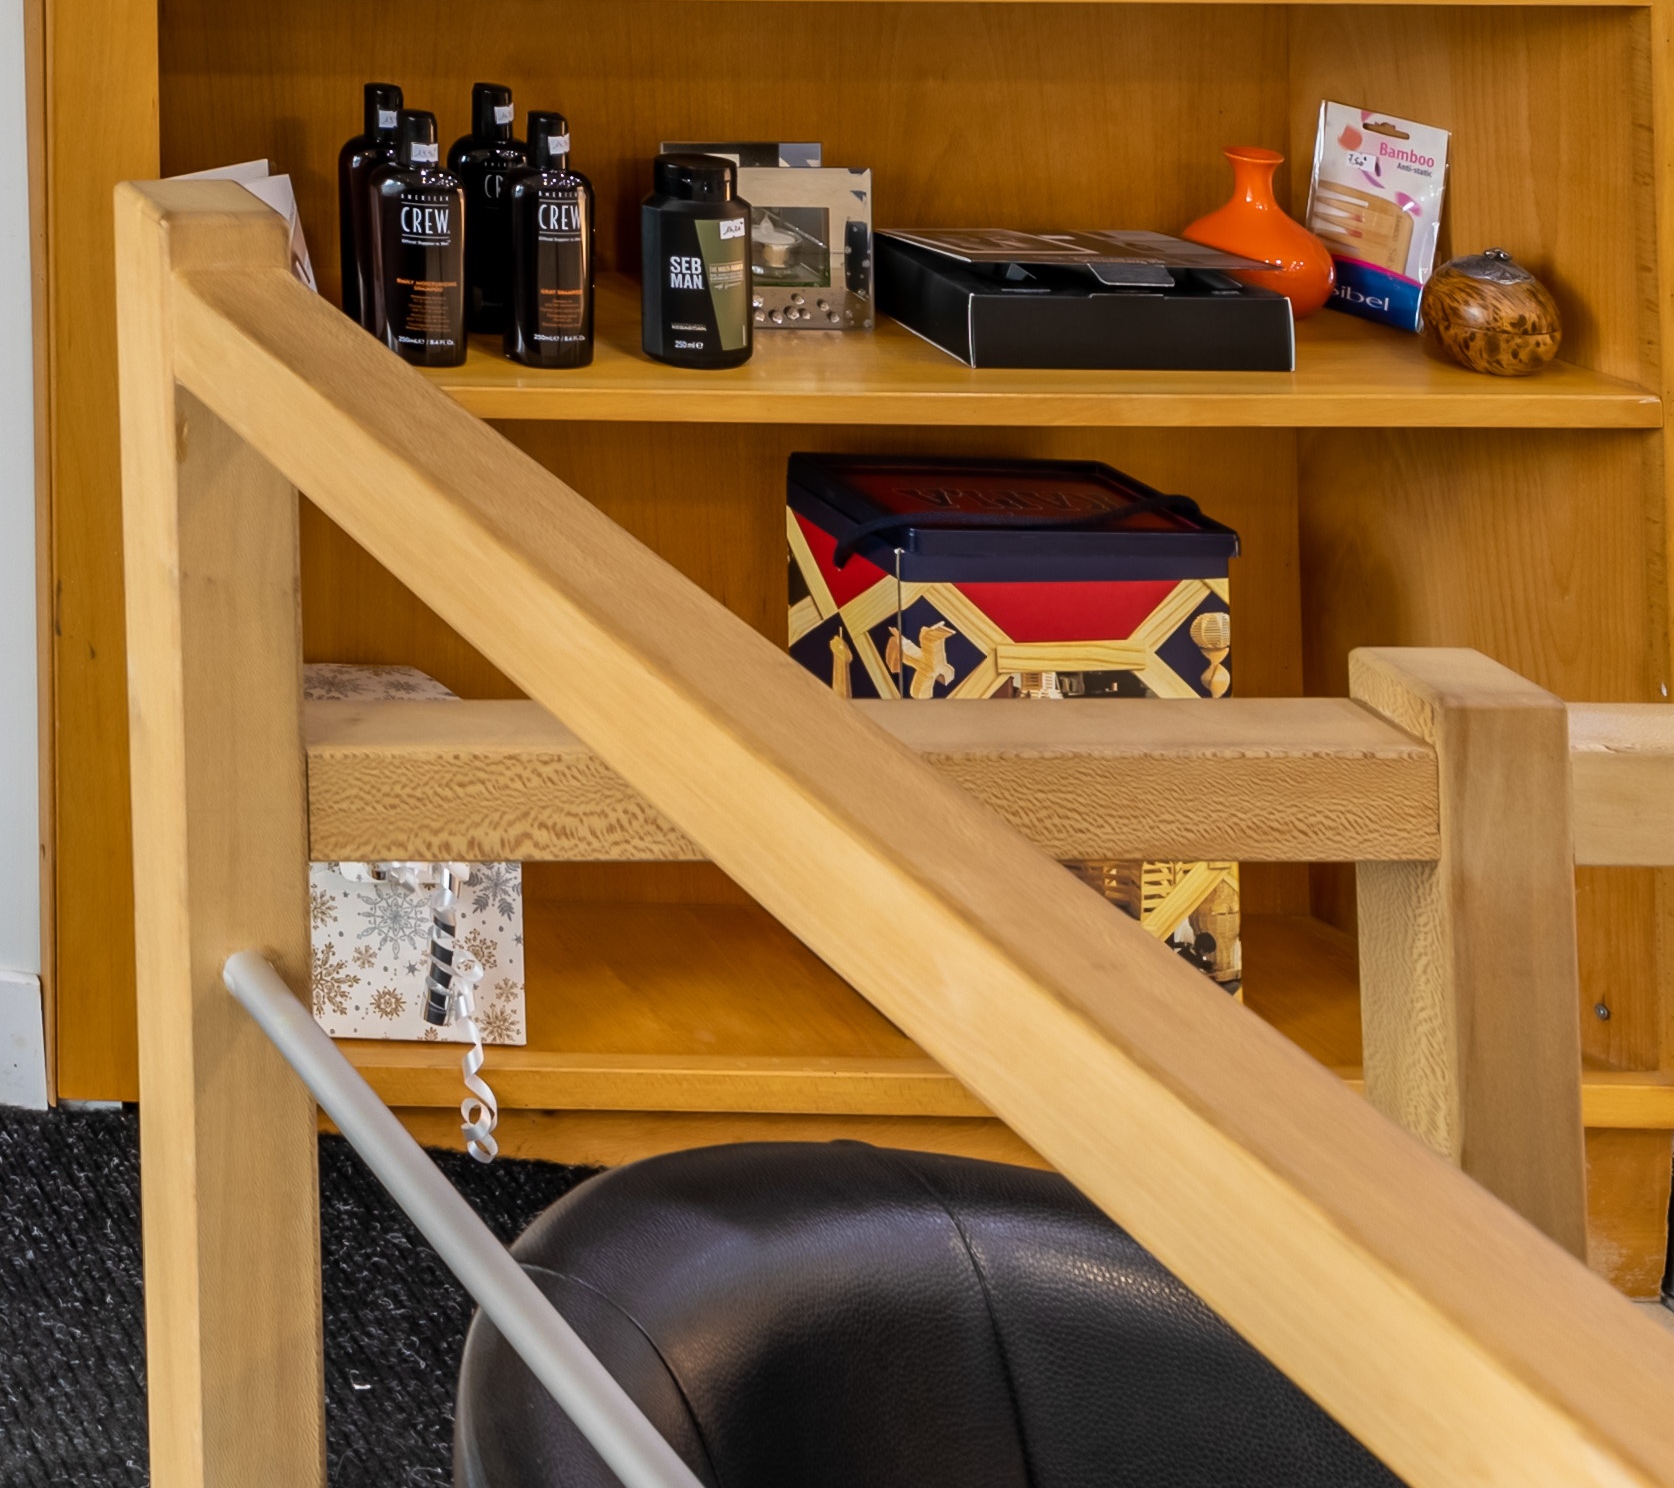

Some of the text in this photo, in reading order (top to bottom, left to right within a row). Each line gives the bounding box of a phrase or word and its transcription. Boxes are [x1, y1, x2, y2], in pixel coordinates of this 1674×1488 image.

[1379, 141, 1435, 169] Bamboo
[1396, 162, 1433, 179] Anti-static
[401, 193, 450, 202] AMERICAN
[400, 206, 450, 235] CREW
[538, 204, 582, 231] CREW
[670, 256, 702, 274] SEB
[396, 277, 414, 285] DAILY
[413, 285, 444, 293] SHAMPOO
[670, 274, 704, 290] MAN
